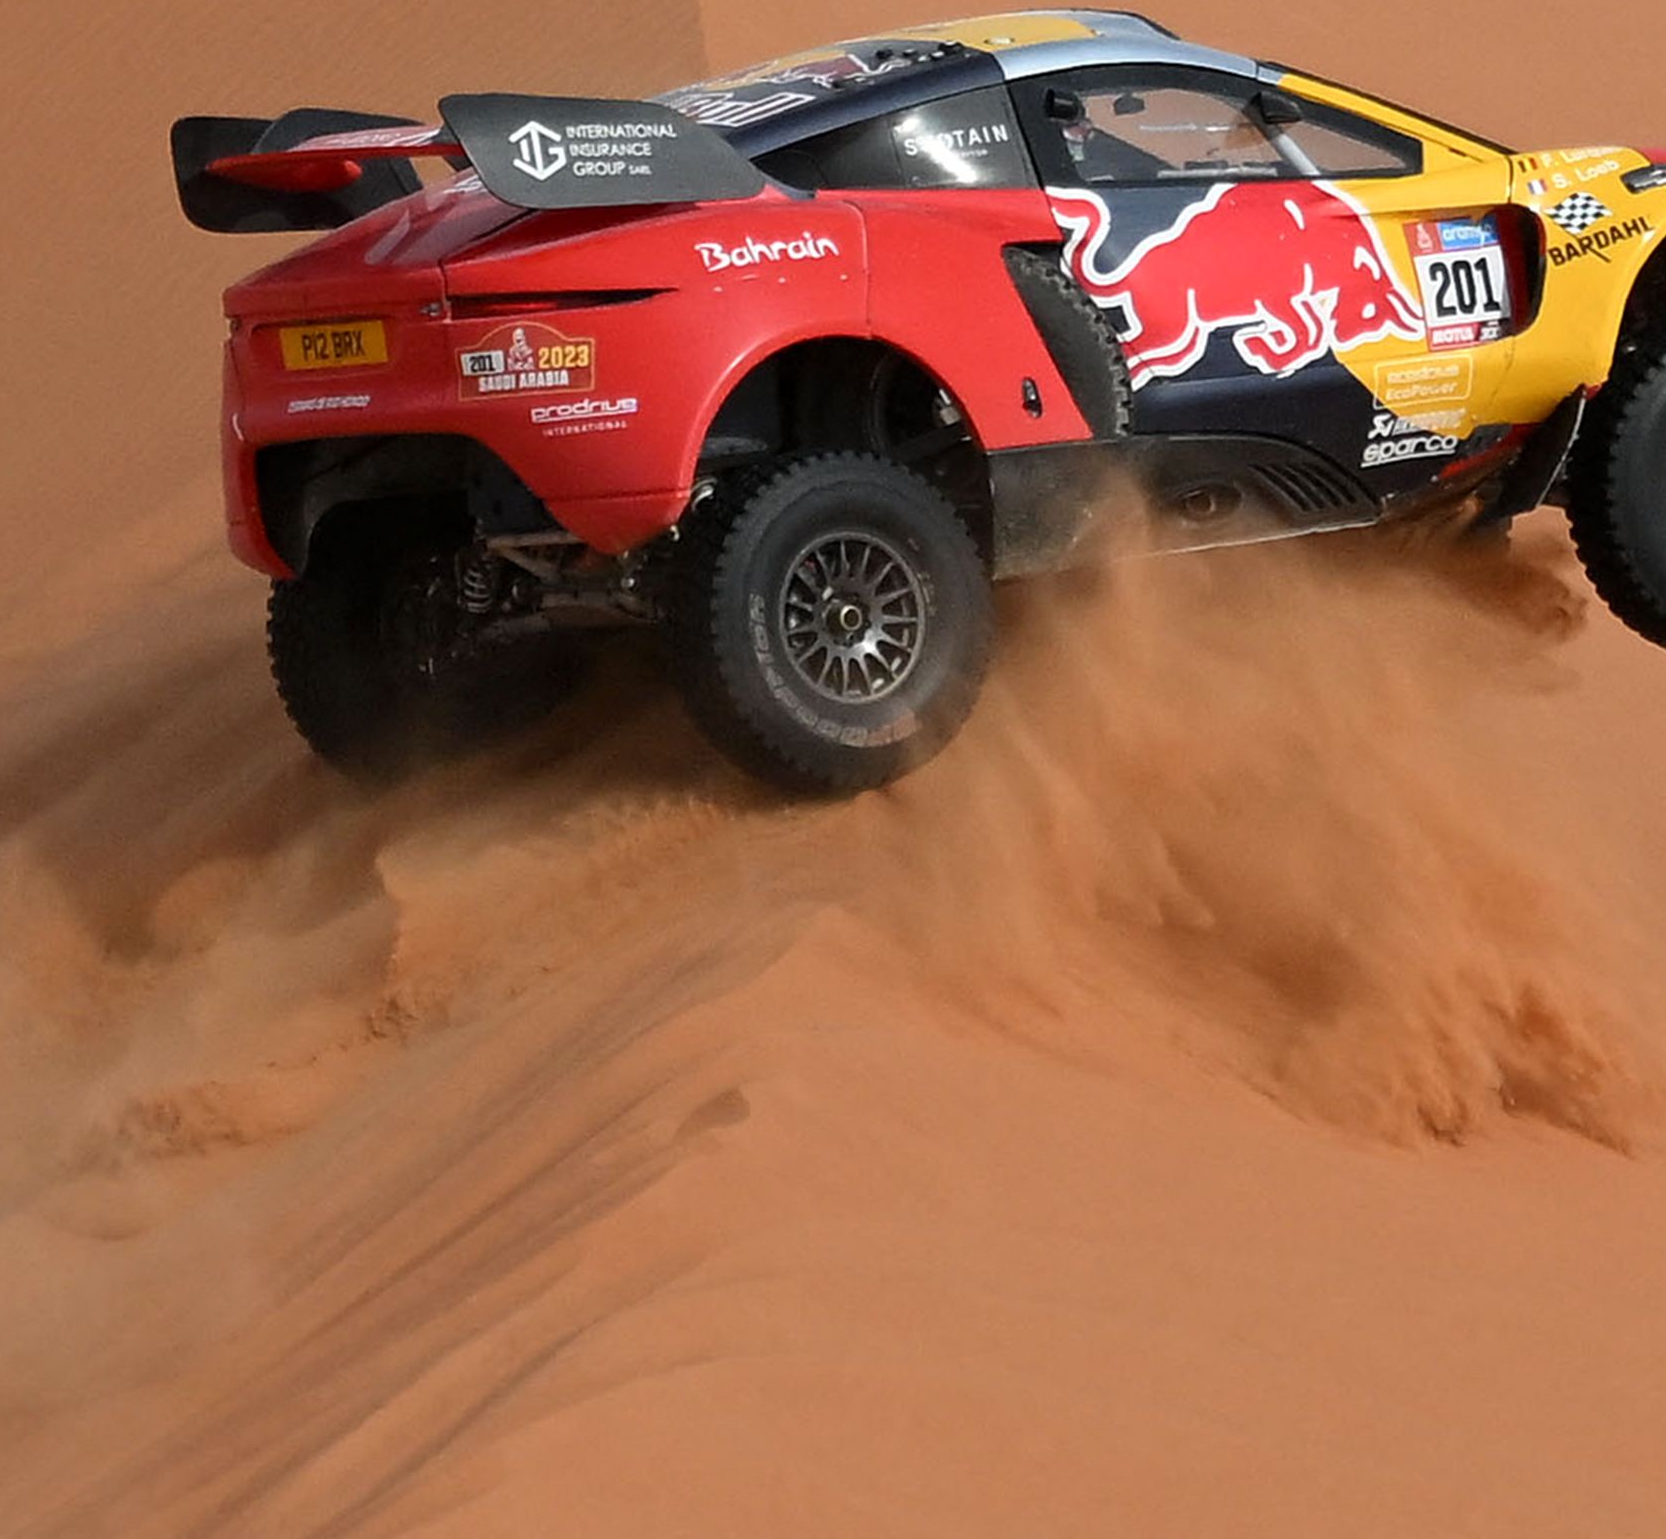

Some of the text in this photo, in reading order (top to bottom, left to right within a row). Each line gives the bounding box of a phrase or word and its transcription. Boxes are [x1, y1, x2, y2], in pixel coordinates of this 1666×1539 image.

[565, 123, 678, 140] INTERNATIONAL
[568, 142, 653, 158] INSURANCE
[572, 161, 627, 177] GROUP
[1551, 160, 1621, 189] S. Loeb
[693, 231, 840, 273] Bahrain
[1548, 216, 1655, 267] BARDAHL
[1428, 257, 1502, 318] 201
[331, 330, 366, 359] BRX
[469, 354, 497, 373] 201
[538, 345, 590, 370] 2023
[478, 370, 570, 393] SAUDI ARABIA
[531, 398, 638, 423] prodrive
[542, 420, 628, 437] INTERNATIONAL
[1362, 435, 1459, 465] sparco
